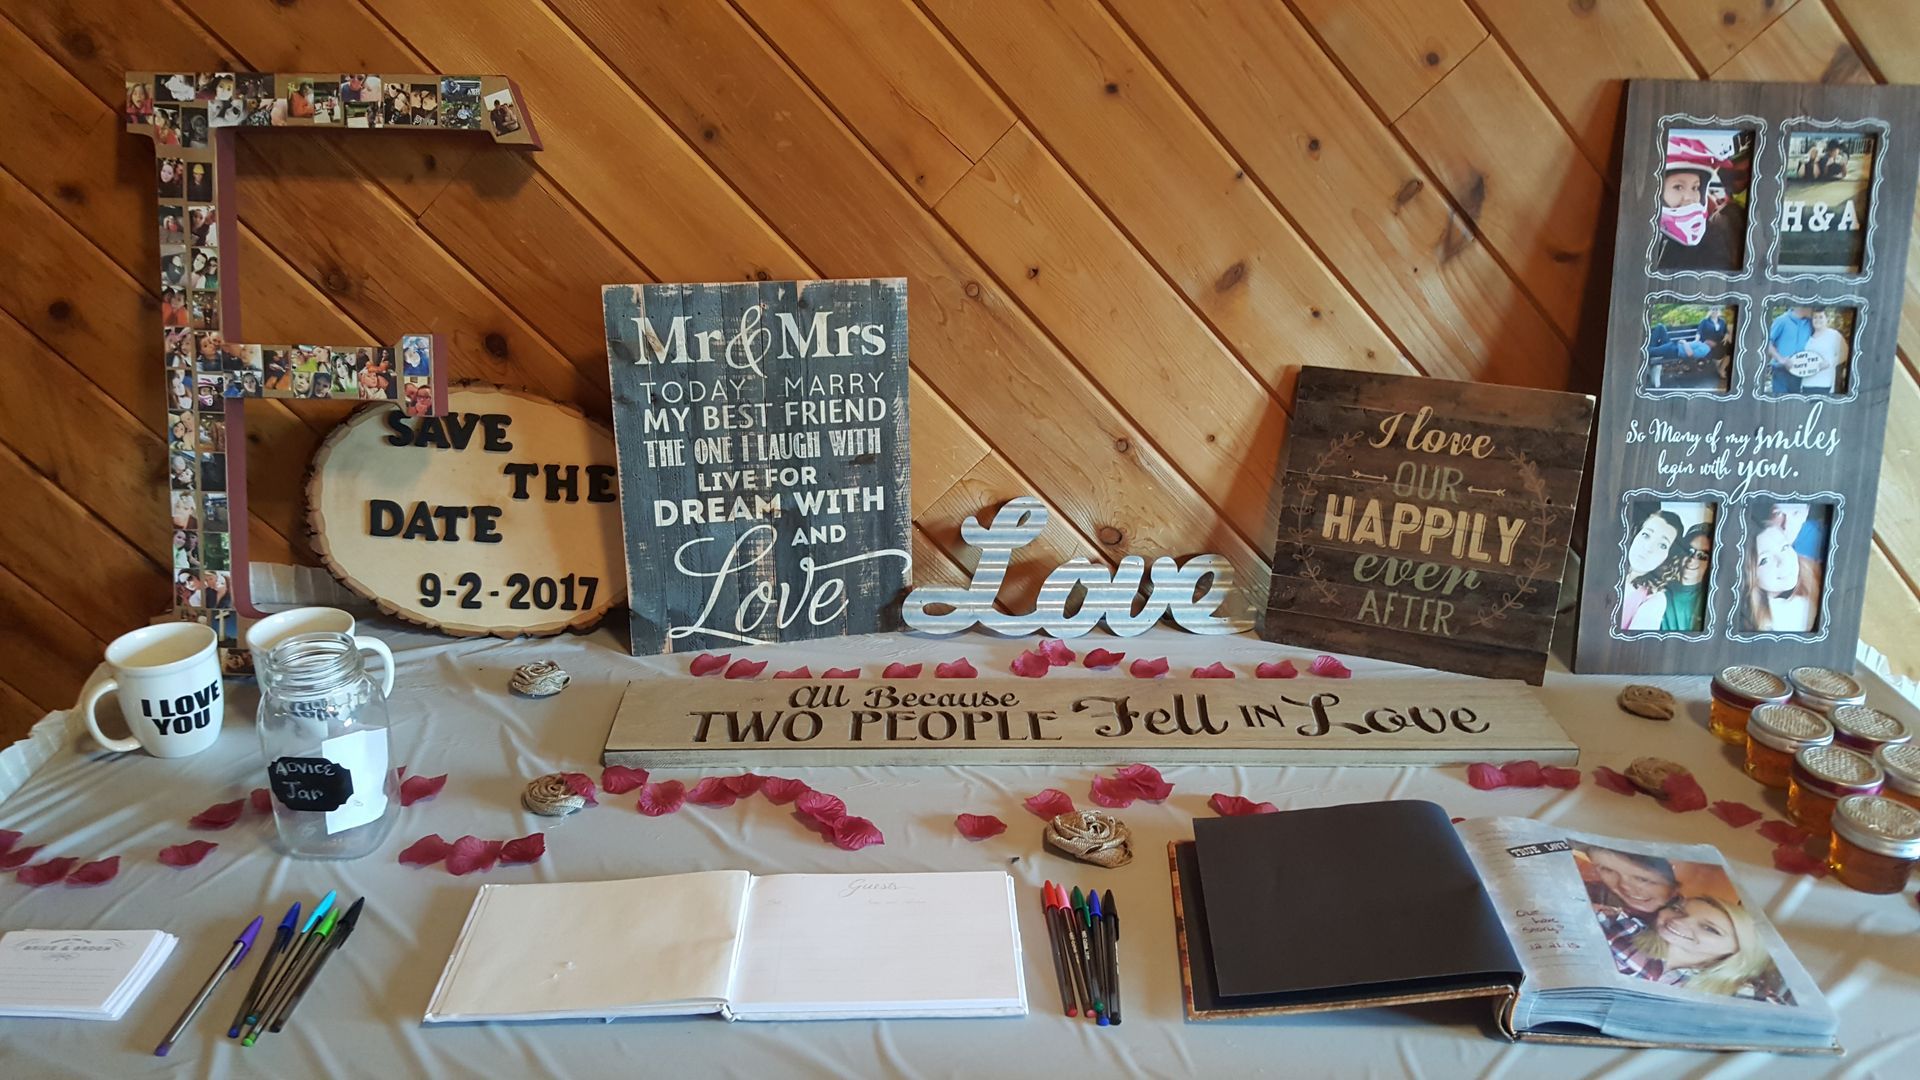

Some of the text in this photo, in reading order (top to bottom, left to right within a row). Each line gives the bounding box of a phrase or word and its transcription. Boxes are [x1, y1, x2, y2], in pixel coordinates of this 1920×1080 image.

[630, 304, 887, 379] Mr & Mrs
[640, 378, 747, 404] TODAY
[784, 372, 885, 398] MARRY
[386, 410, 514, 452] SAVE
[643, 397, 887, 434] MY BEST FRIEND
[1368, 405, 1496, 459] I love
[1625, 401, 1841, 457] So Many of my smiles
[643, 427, 882, 468] THE ONE I LAUGH WITH
[1656, 449, 1696, 487] begin
[1700, 449, 1731, 480] with
[503, 462, 617, 503] THE
[698, 466, 818, 493] LIVE FOR
[1393, 460, 1464, 504] OUR
[368, 499, 503, 543] DATE
[654, 486, 885, 527] DREAM WITH
[791, 524, 847, 547] AND
[1321, 493, 1527, 567] HAPPILY
[668, 524, 912, 644] Love
[902, 496, 1256, 638] Love
[1352, 553, 1484, 596] ever
[419, 572, 599, 611] 9-2-2017
[1357, 589, 1455, 637] AFTER
[141, 679, 220, 718] I LOVE
[688, 692, 1490, 743] TWO PEOPLE Fell IN Love
[863, 685, 1020, 709] Because
[151, 707, 211, 736] YOU
[274, 761, 336, 777] ADVICE
[282, 780, 324, 802] Jar
